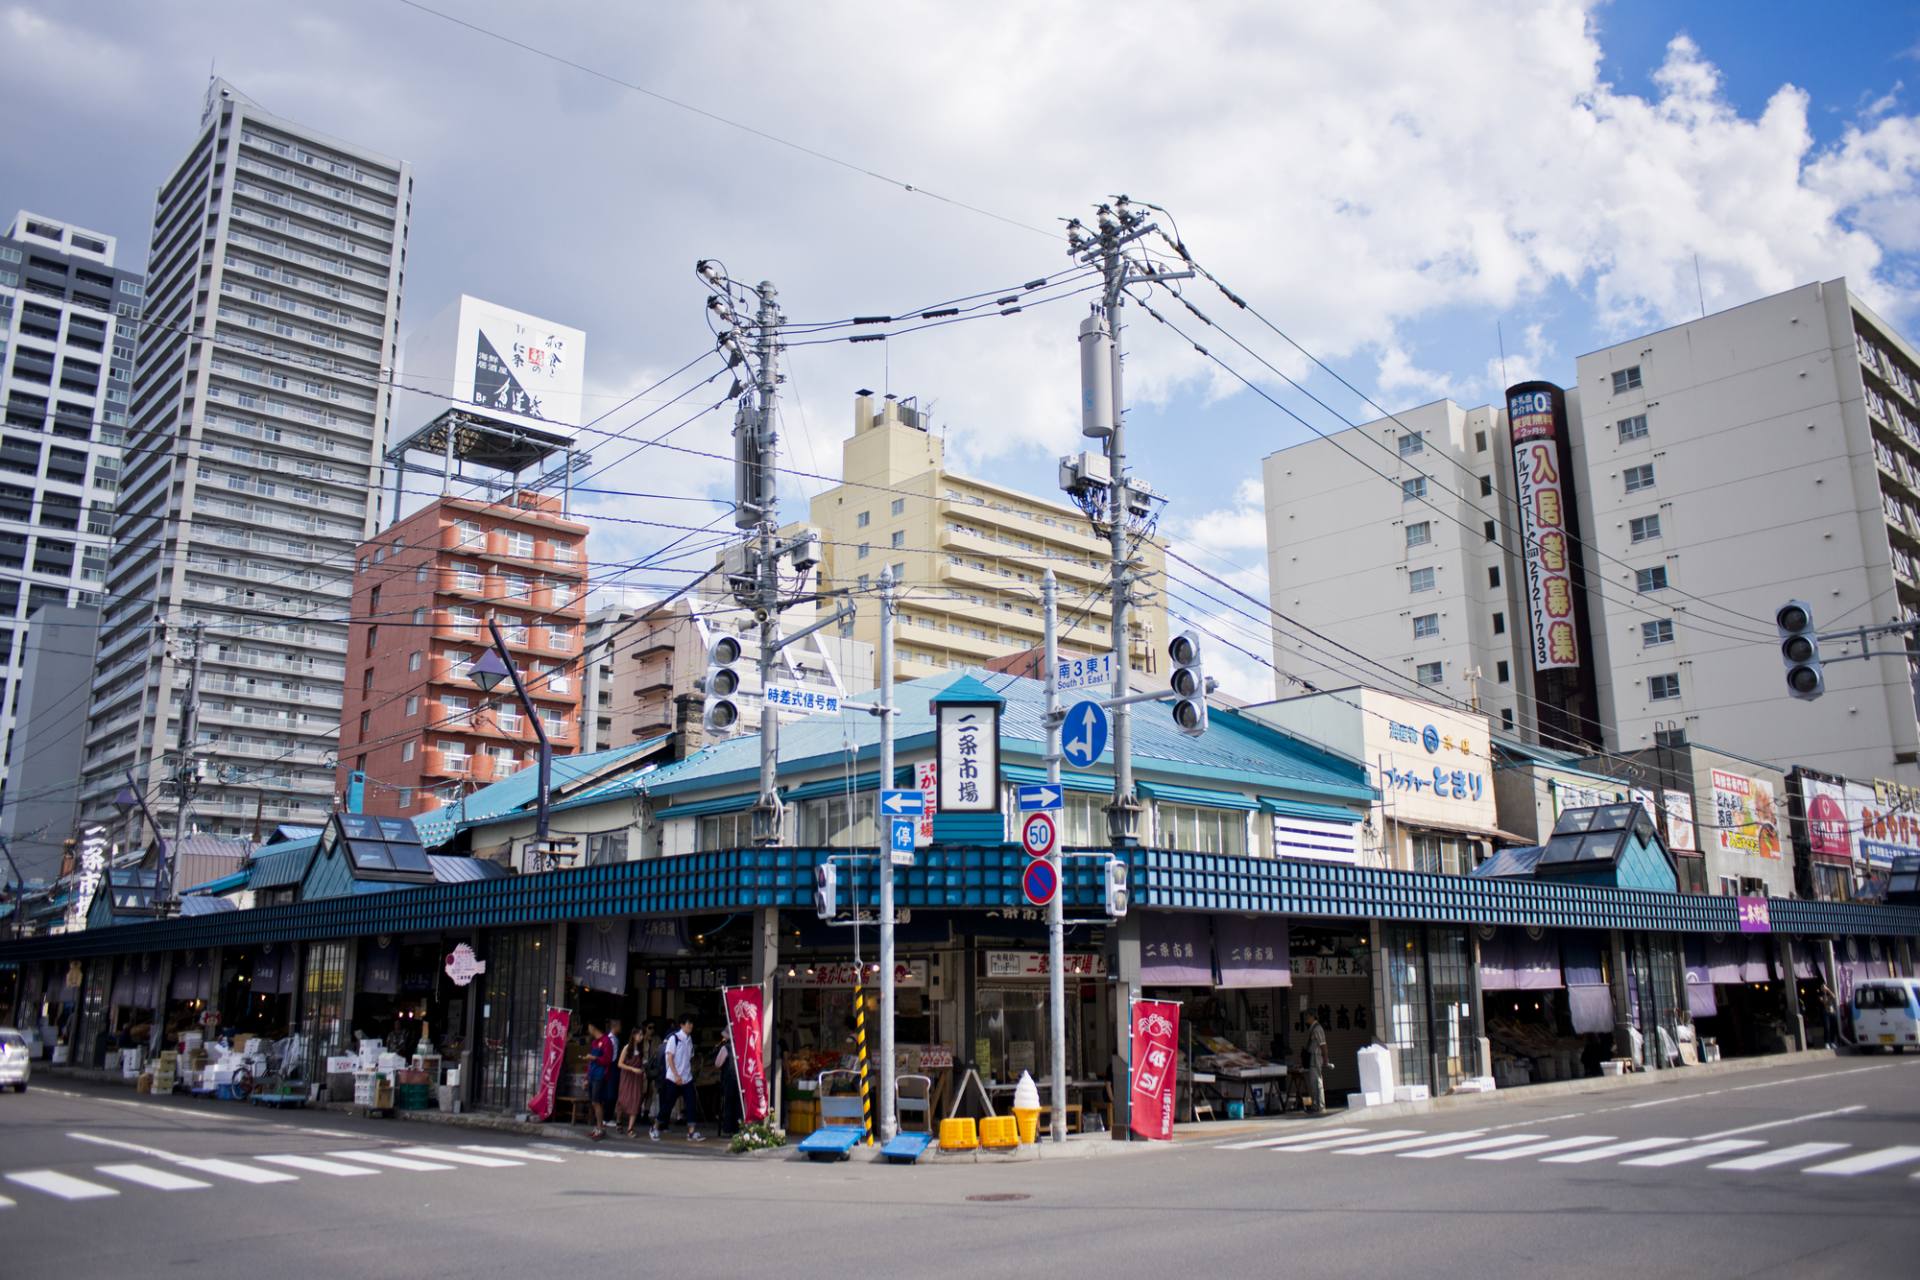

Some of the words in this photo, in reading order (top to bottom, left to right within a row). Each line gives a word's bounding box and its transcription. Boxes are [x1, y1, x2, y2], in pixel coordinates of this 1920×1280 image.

[1516, 448, 1535, 532] アルファコート
[1529, 561, 1547, 665] 272-7733
[1531, 444, 1577, 664] 入居者募集
[1058, 655, 1110, 680] 南3東1
[1057, 678, 1078, 690] South
[1079, 677, 1085, 686] 3
[1087, 674, 1105, 685] East
[767, 687, 838, 712] 時差式信号機
[957, 713, 980, 803] 二条市場
[895, 826, 912, 848] 停
[1029, 824, 1049, 846] 50
[1144, 942, 1194, 959] 二条市場
[1230, 946, 1275, 962] 二条市場
